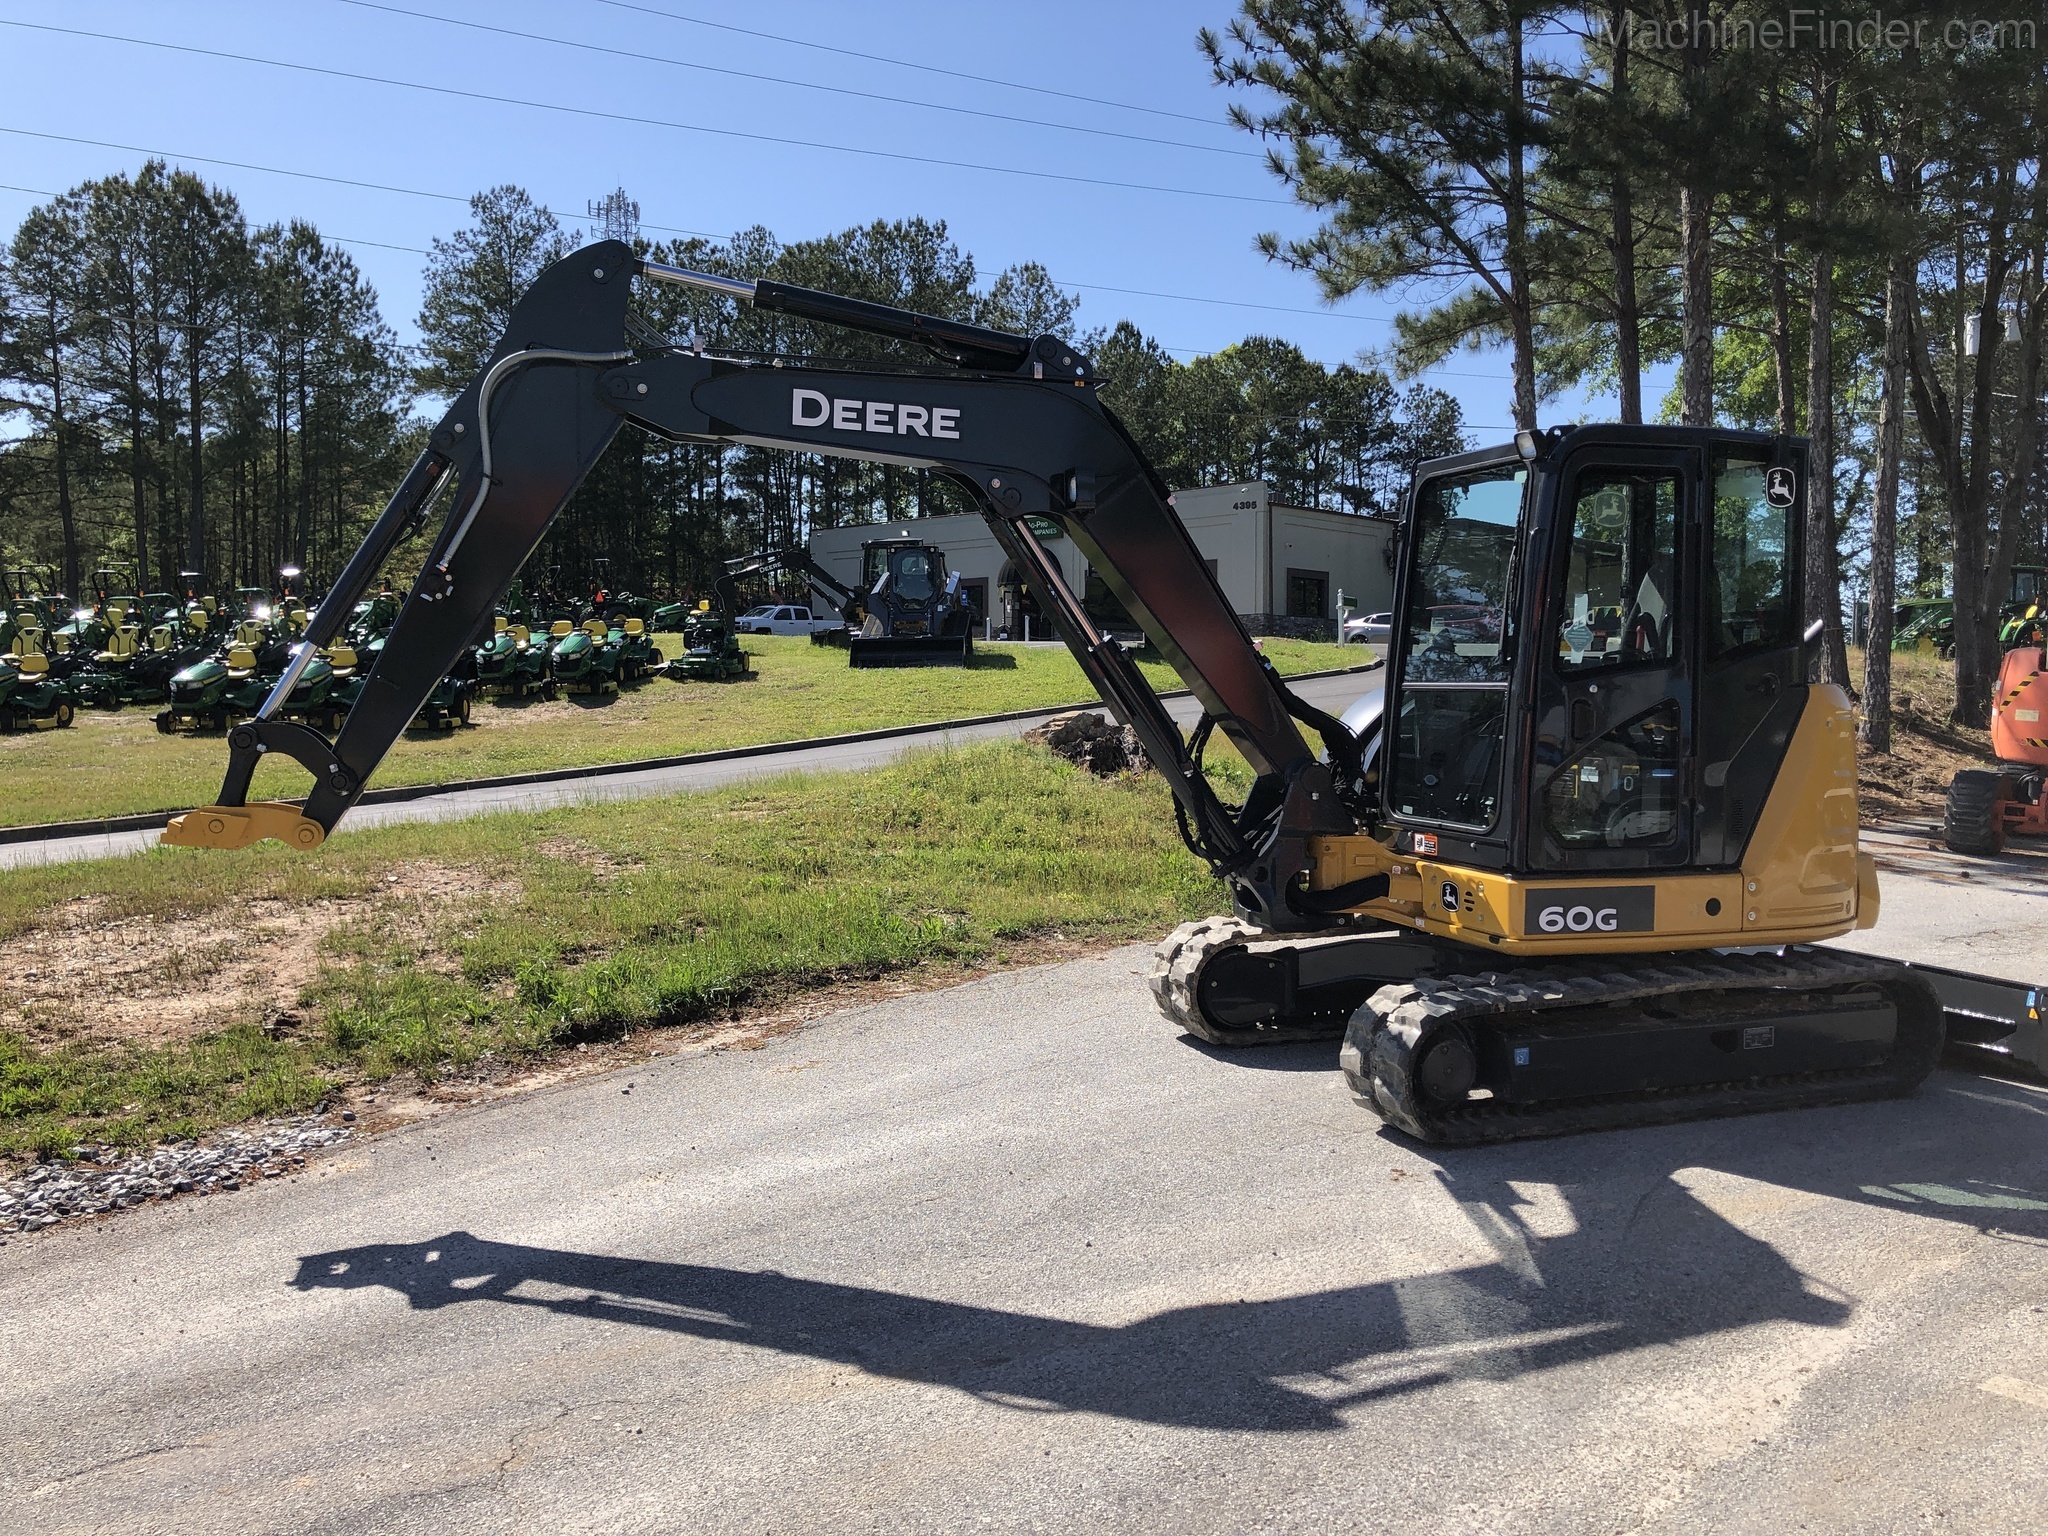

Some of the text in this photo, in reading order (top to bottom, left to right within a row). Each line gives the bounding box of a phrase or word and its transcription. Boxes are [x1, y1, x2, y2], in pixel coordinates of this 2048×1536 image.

[792, 388, 960, 439] DEERE
[1233, 501, 1257, 510] 4395
[759, 562, 782, 573] DEERE
[1538, 905, 1617, 932] 60G
